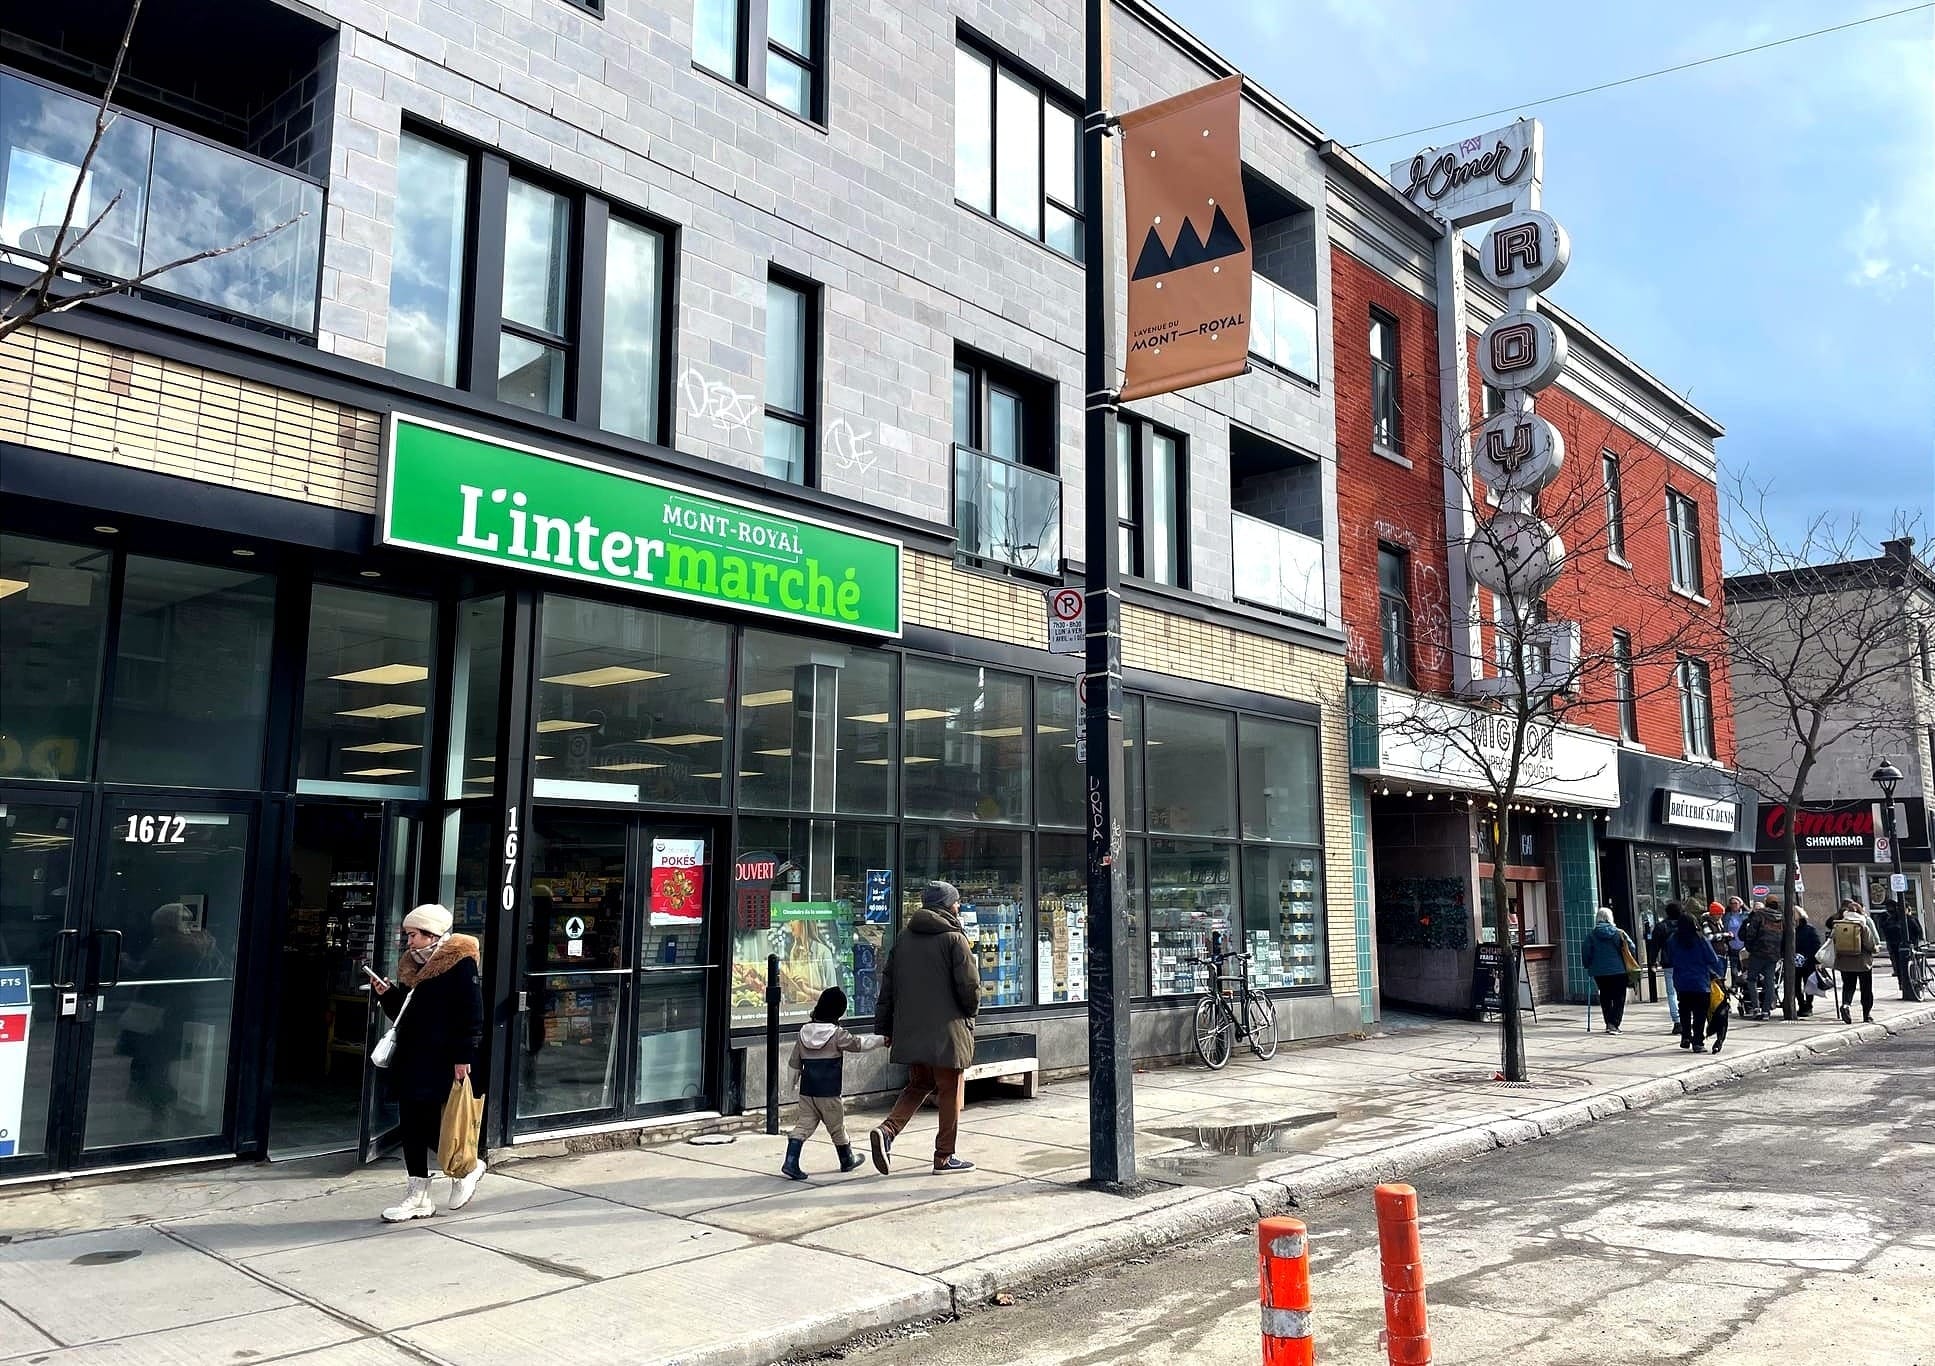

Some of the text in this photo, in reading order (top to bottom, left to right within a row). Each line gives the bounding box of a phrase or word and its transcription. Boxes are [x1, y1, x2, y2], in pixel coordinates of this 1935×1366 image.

[1168, 320, 1179, 329] DU
[662, 503, 803, 555] MONT-ROYAL
[456, 484, 860, 621] L'intermarché
[125, 814, 186, 843] 1672
[1806, 835, 1864, 847] SHAWARMA
[502, 806, 518, 911] 1670
[661, 854, 696, 866] POKÉS
[735, 862, 775, 881] OUVERT
